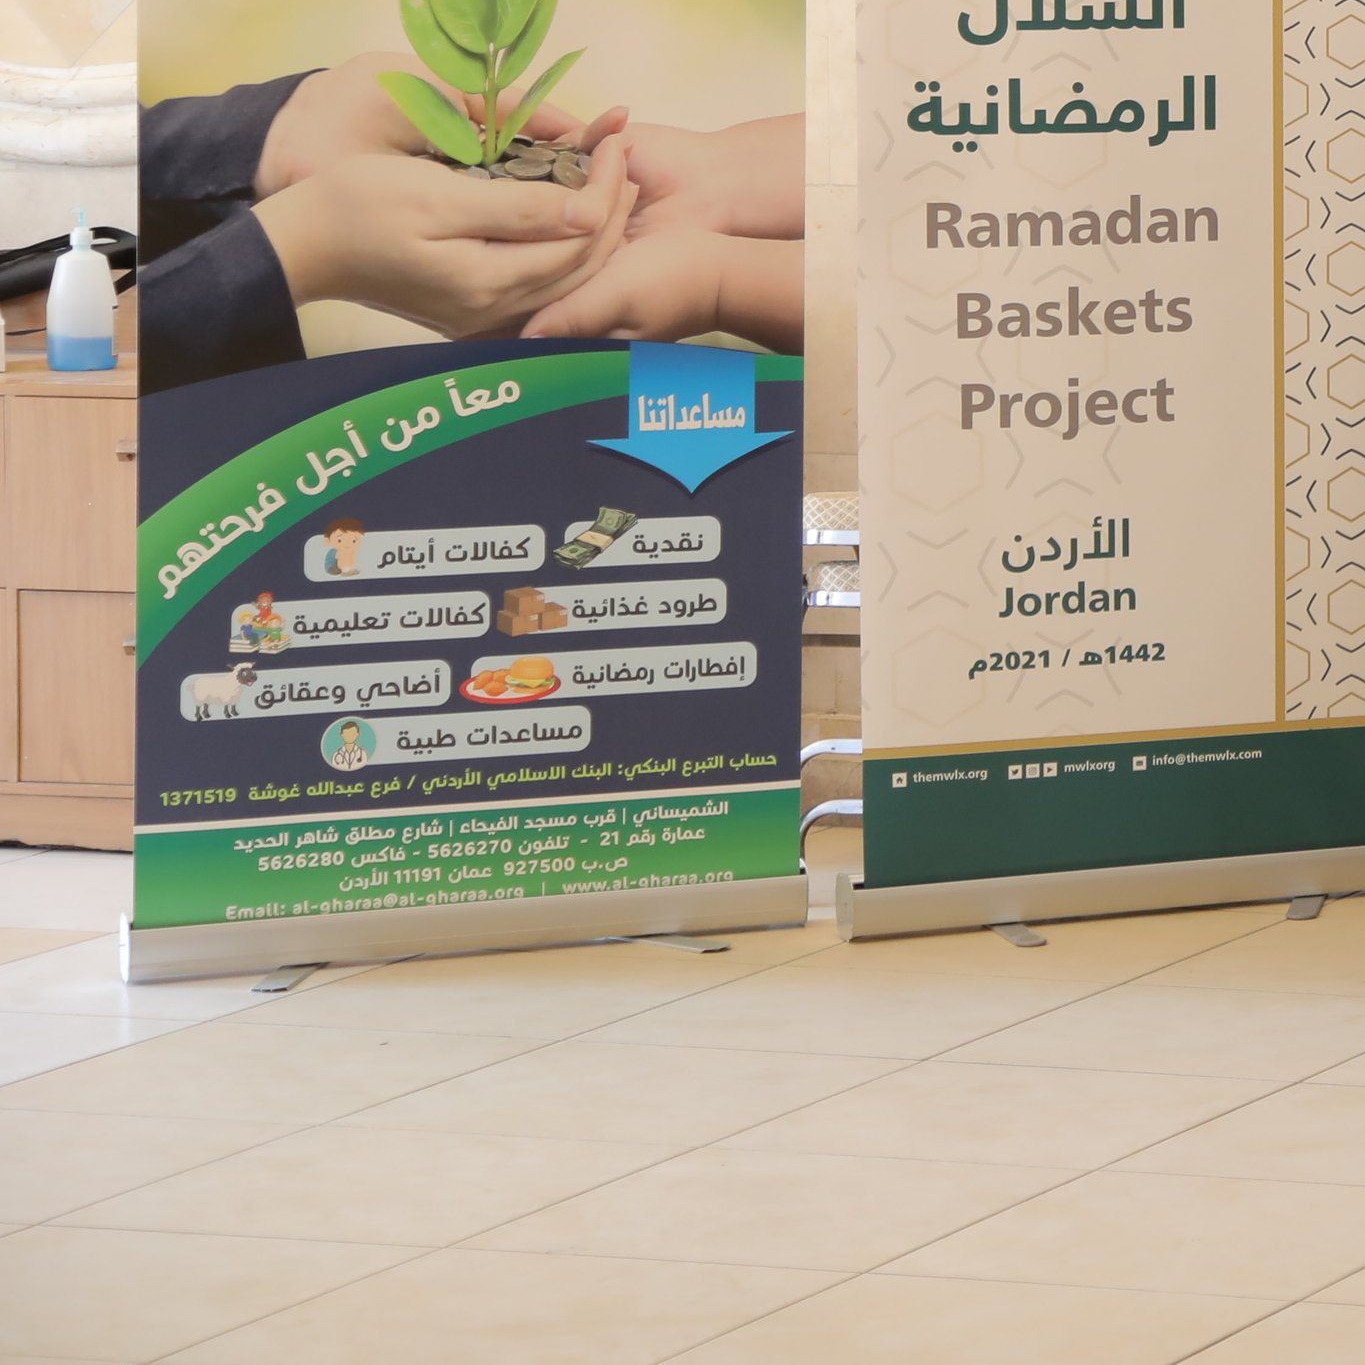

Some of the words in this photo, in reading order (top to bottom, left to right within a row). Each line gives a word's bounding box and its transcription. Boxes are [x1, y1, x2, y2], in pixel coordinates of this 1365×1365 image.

[906, 74, 1216, 153] الرمضانية
[925, 194, 1219, 249] Ramadan
[956, 286, 1193, 339] Baskets
[637, 392, 746, 432] مساعداتنا
[960, 377, 1175, 440] Project
[381, 405, 441, 452] من
[295, 420, 368, 496] أجل
[157, 482, 287, 600] فرحتهم
[445, 536, 531, 561] كفالات
[632, 532, 704, 559] نقدية
[1001, 515, 1130, 572] الأردن
[377, 538, 435, 570] أيتام
[572, 595, 649, 623] غذائية
[658, 593, 717, 618] طرود
[999, 581, 1137, 618] Jordan
[292, 611, 391, 640] تعليمية
[399, 602, 487, 629] كفالات
[572, 662, 654, 690] رمضانية
[664, 655, 745, 681] إفطارات
[254, 682, 346, 710] وعقائق
[356, 667, 440, 707] أضاحي
[396, 729, 456, 755] طبية
[466, 723, 583, 747] مساعدات
[571, 763, 612, 780] البنك
[617, 758, 676, 781] البنكي:
[682, 755, 724, 777] التبرع
[729, 753, 777, 769] حساب
[912, 768, 988, 784] themwlx.org
[1063, 759, 1116, 775] mwlxorg
[1152, 749, 1262, 767] info@themwlx.com
[306, 781, 365, 798] عبدالله
[370, 777, 401, 798] فرع
[422, 770, 481, 795] الأردني
[487, 766, 566, 791] الاسلامي
[160, 788, 236, 806] 1371519
[248, 782, 300, 802] غوشة
[459, 815, 518, 835] الفيحاء
[524, 815, 577, 832] مسجد
[583, 808, 616, 829] قرب
[632, 799, 729, 828] الشميساني
[233, 832, 289, 852] الحديد
[295, 825, 339, 848] شاهر
[345, 824, 395, 845] مطلق
[401, 818, 443, 843] شارع
[599, 831, 620, 847] 21
[626, 830, 656, 847] رقم
[661, 827, 706, 842] عمارة
[351, 847, 406, 868] فاكس
[427, 840, 512, 859] 5626270
[518, 835, 570, 856] تلفون
[257, 851, 345, 872] 5626280
[503, 857, 576, 877] 927500
[339, 868, 388, 892] الأردن
[393, 867, 442, 884] 11191
[448, 865, 492, 884] عمان
[225, 904, 286, 921] Email:
